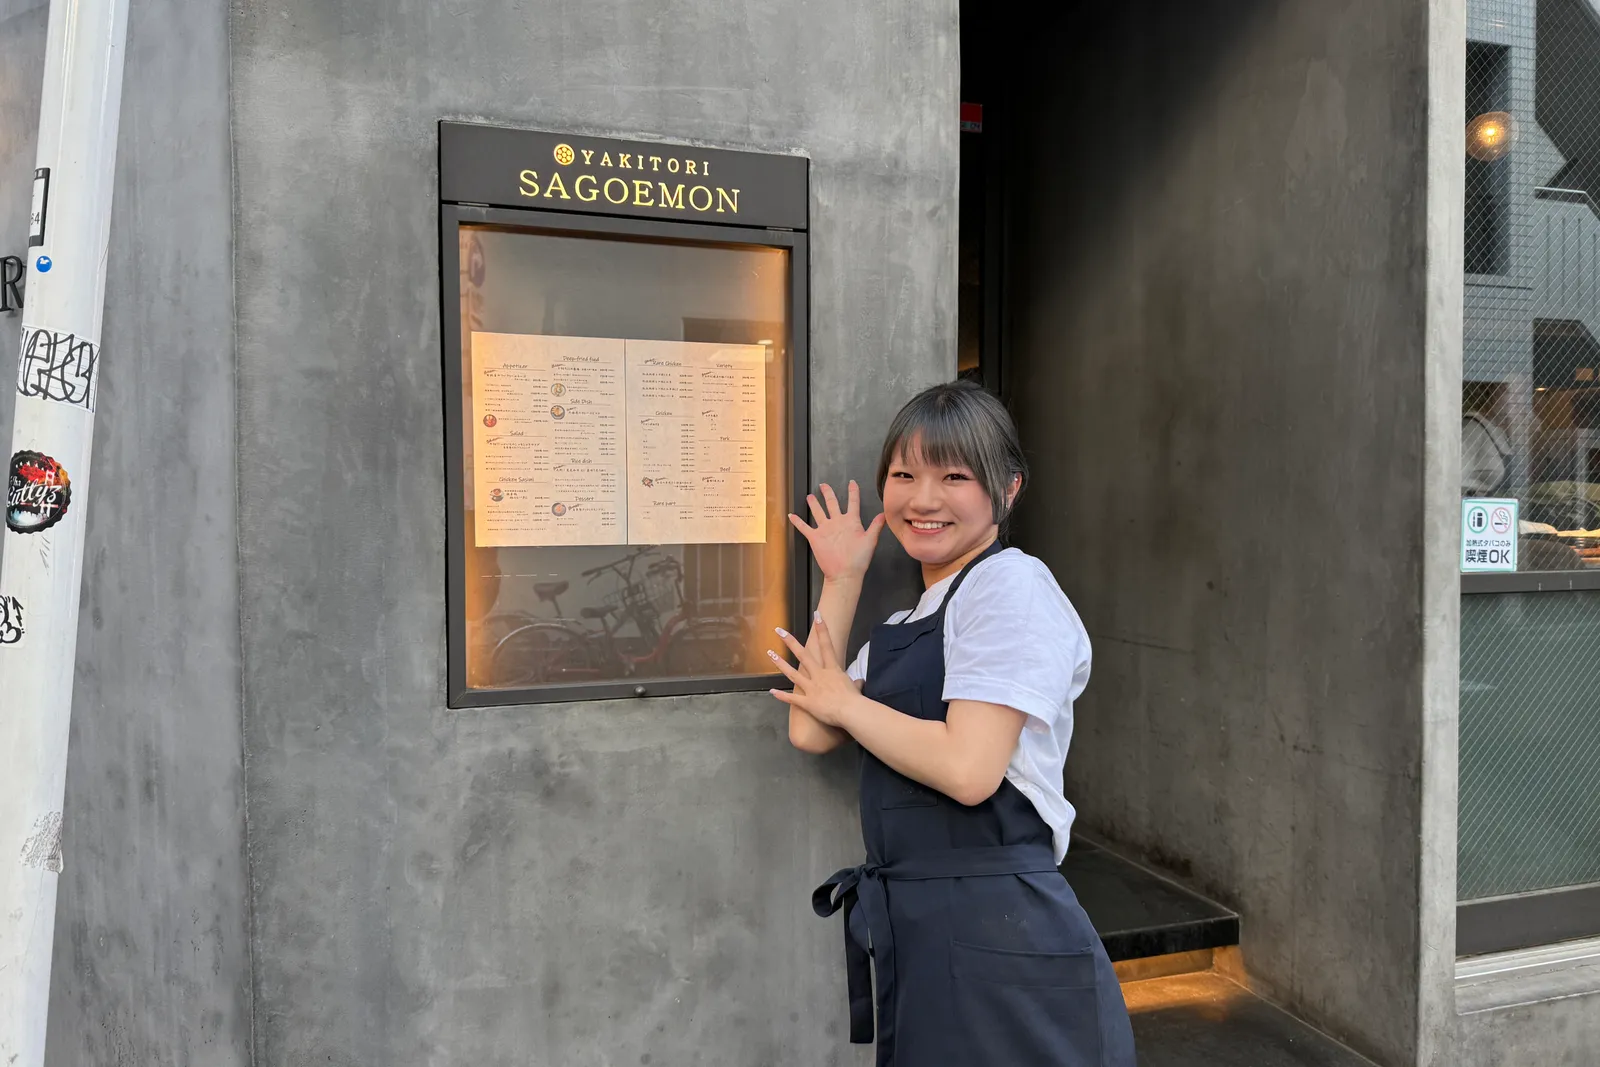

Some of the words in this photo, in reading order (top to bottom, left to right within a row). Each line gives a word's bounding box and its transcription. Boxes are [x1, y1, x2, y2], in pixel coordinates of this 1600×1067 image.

[581, 149, 710, 176] YAKITORI
[519, 169, 741, 214] SAGOEMON
[0, 254, 24, 313] R
[1465, 549, 1511, 564] 喫煙OK
